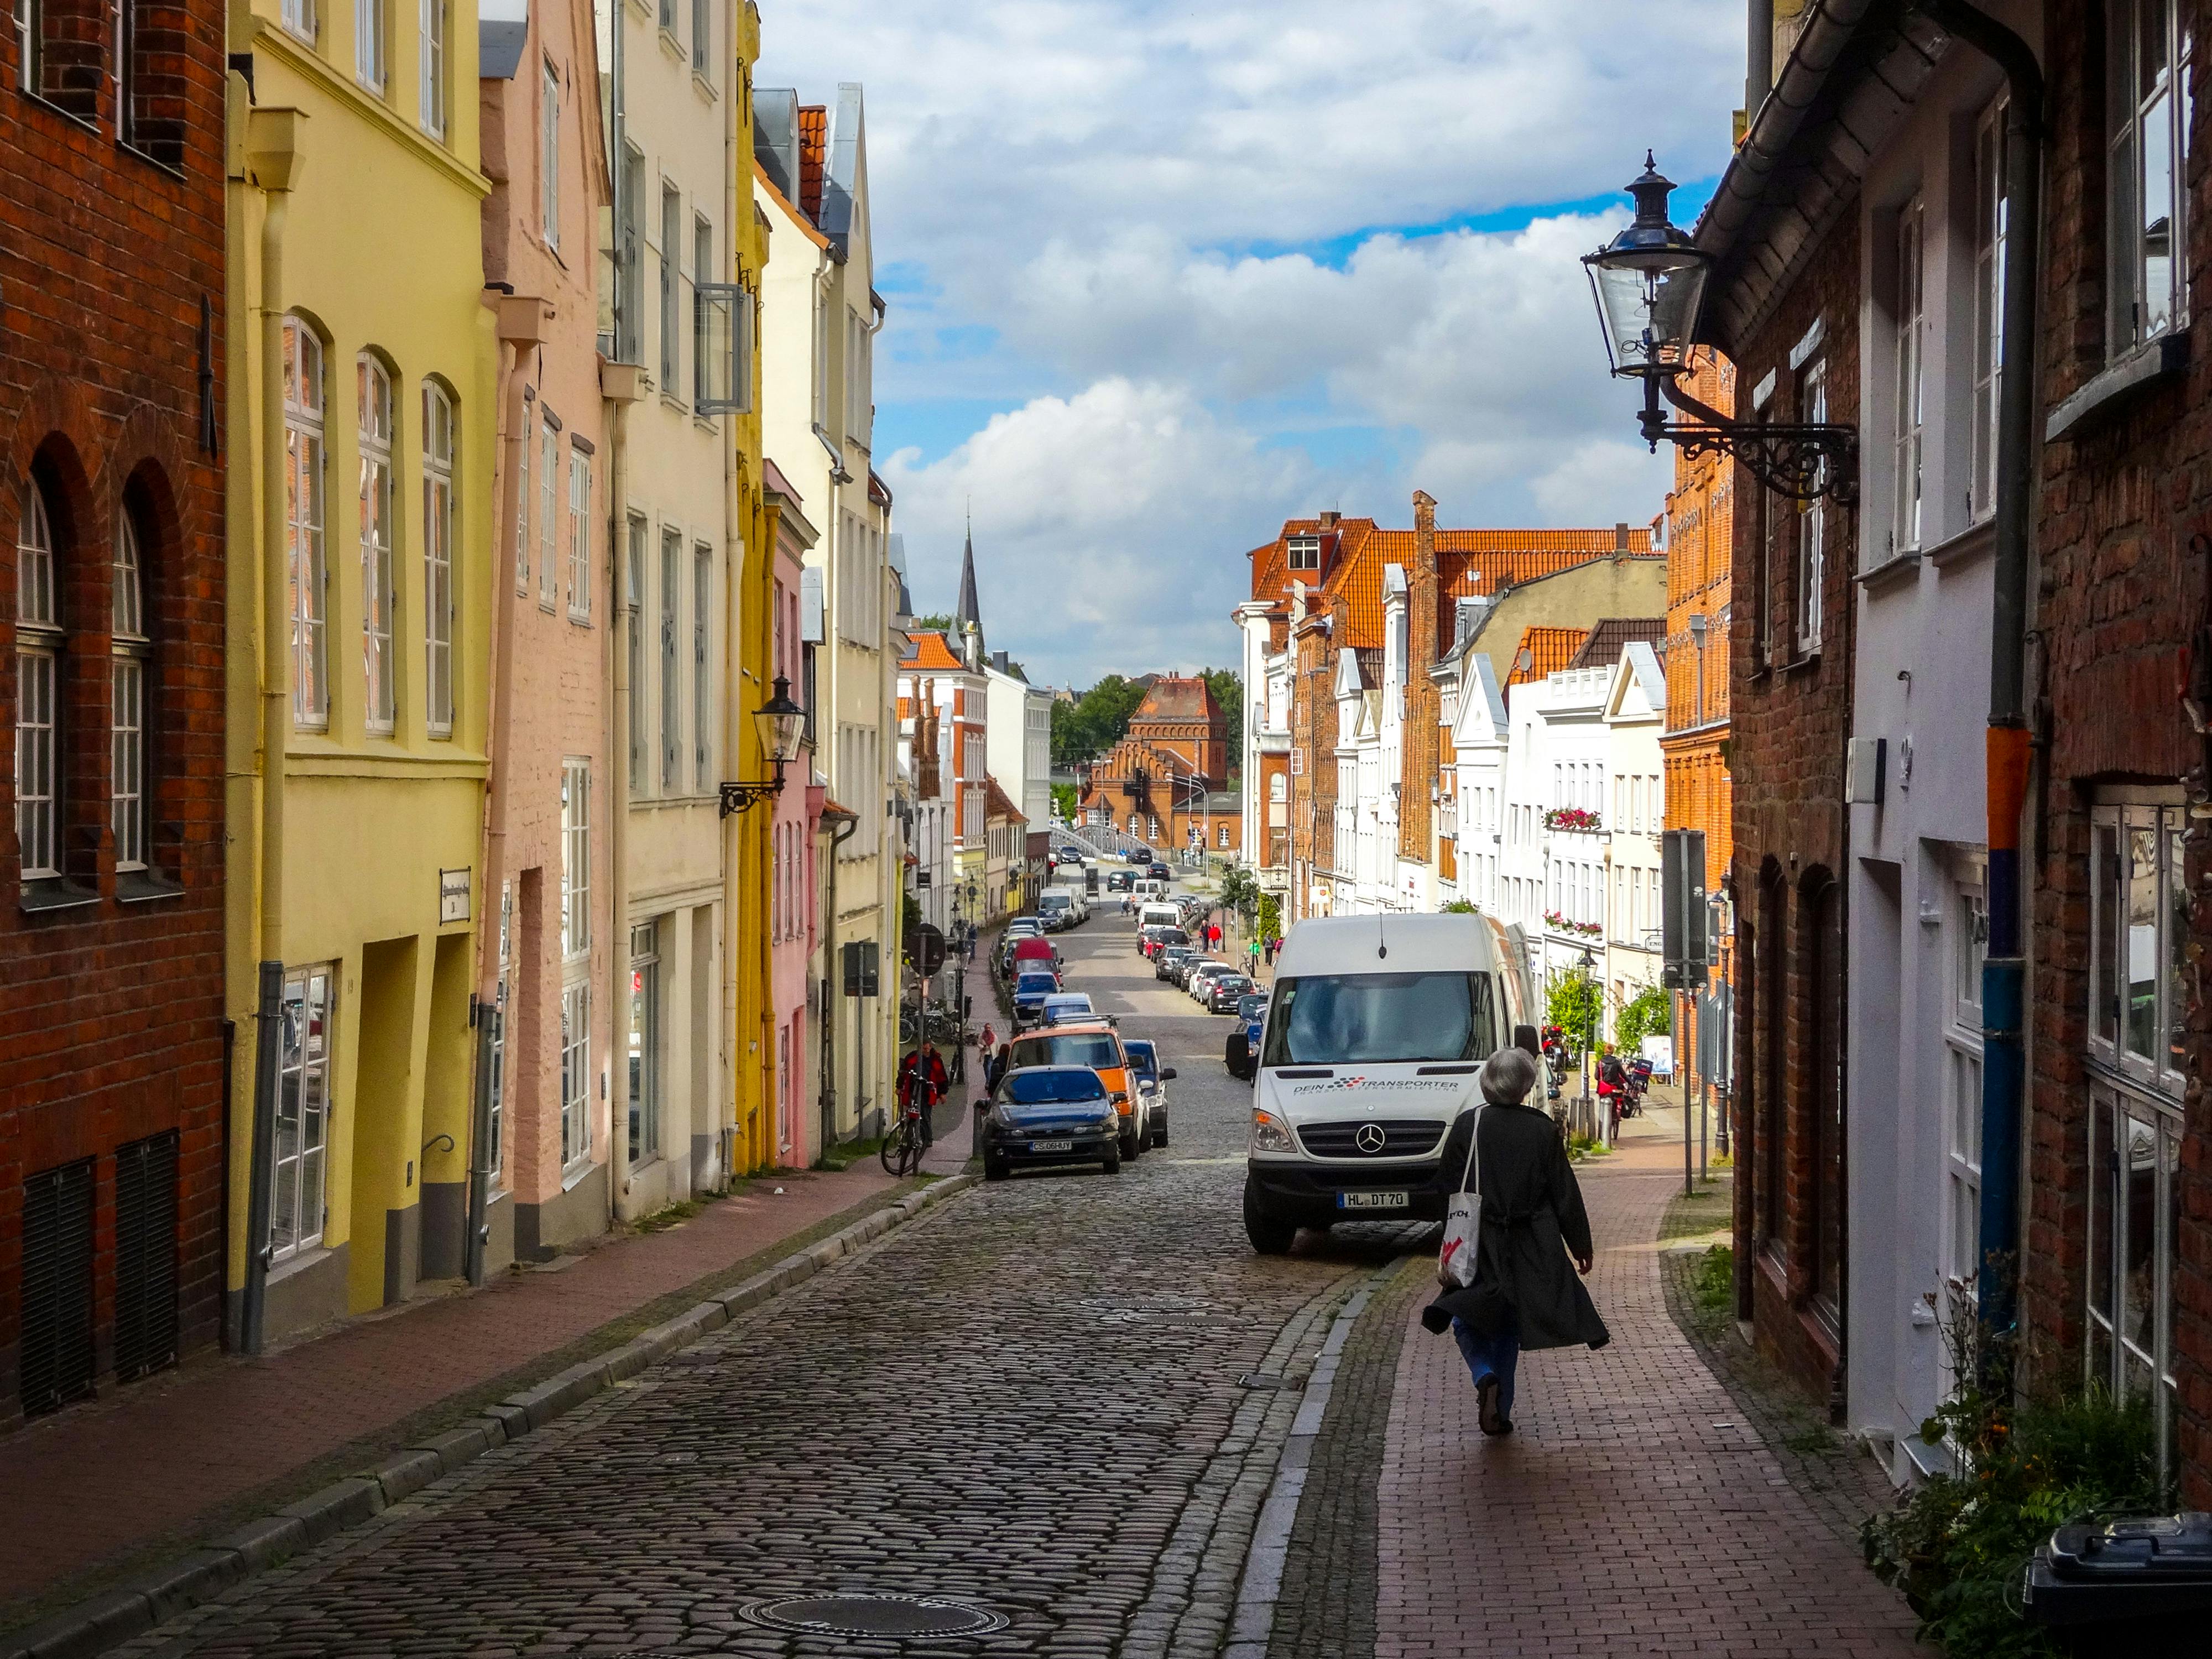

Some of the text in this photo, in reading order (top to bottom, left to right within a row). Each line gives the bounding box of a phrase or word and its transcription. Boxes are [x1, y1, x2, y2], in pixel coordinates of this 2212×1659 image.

[1294, 1084, 1324, 1093] DEIN
[1348, 1193, 1403, 1206] HL DT 70
